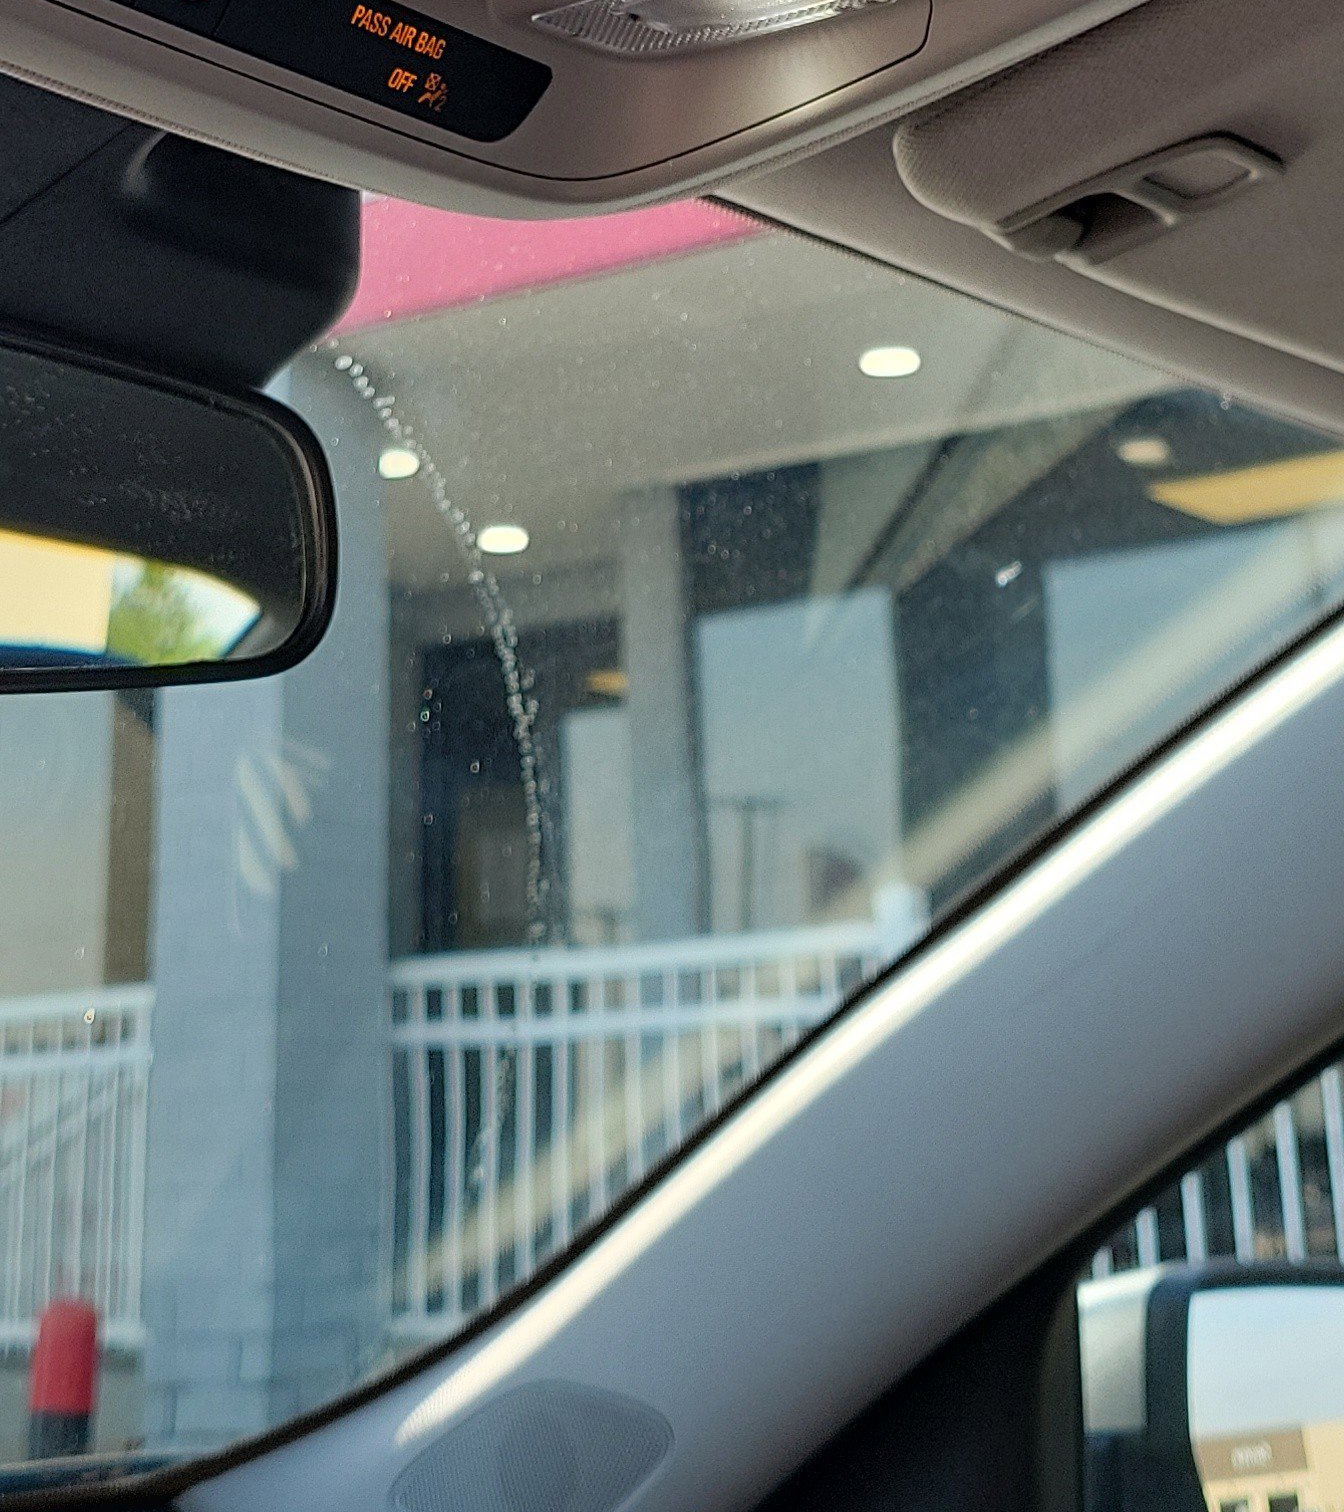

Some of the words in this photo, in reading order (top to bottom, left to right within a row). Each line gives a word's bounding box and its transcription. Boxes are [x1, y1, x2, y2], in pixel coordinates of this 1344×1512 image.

[350, 4, 392, 37] PASS
[389, 22, 417, 48] AIR
[414, 31, 446, 60] BAG
[387, 68, 418, 93] OFF
